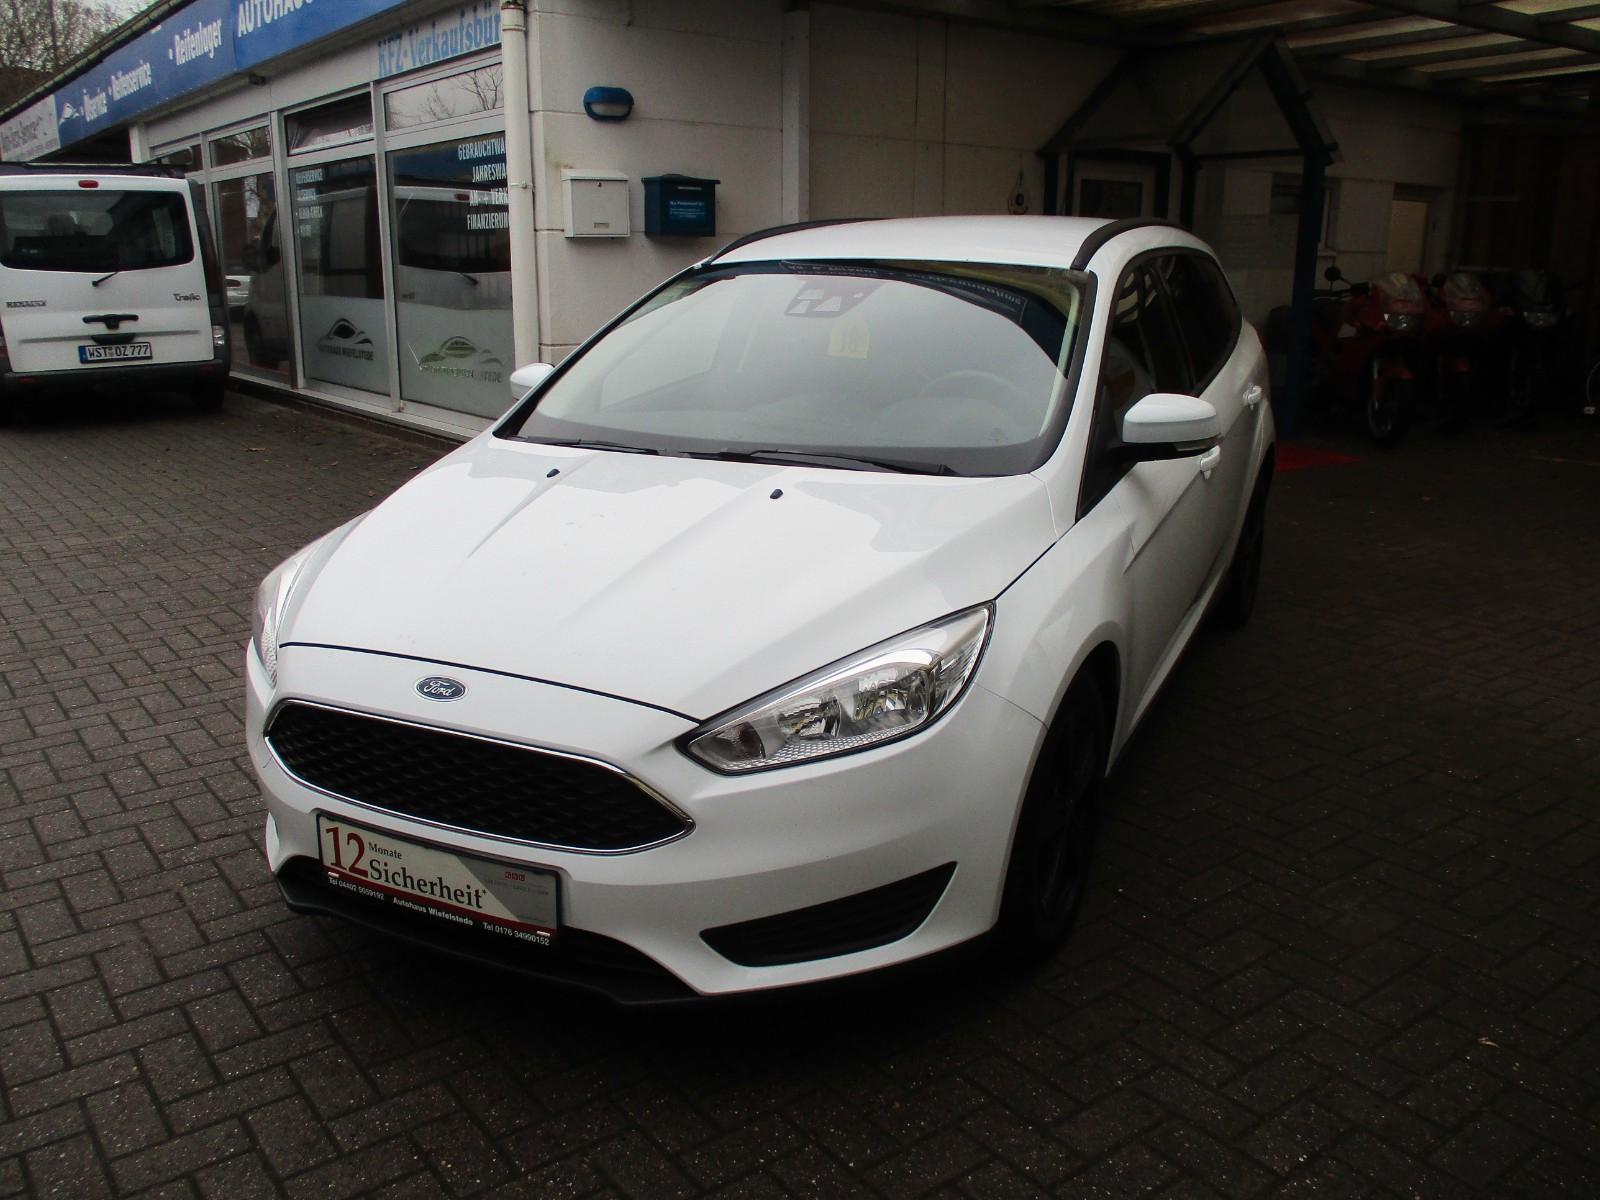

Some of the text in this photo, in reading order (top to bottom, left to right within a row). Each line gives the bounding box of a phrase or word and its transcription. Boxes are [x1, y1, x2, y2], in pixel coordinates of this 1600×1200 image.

[238, 0, 313, 38] AUTOH
[458, 137, 506, 161] GEBRAUCHTWA
[472, 162, 507, 183] JAHRESWA
[466, 212, 509, 230] FINANZIERUN
[87, 346, 109, 359] WST
[130, 344, 149, 356] 777
[423, 680, 456, 697] Ford
[325, 826, 369, 878] 12
[368, 842, 403, 860] Monate
[392, 897, 427, 913] Autohaus
[428, 907, 474, 926] Wiefelstede
[483, 922, 494, 931] Tel
[494, 925, 513, 936] 0176
